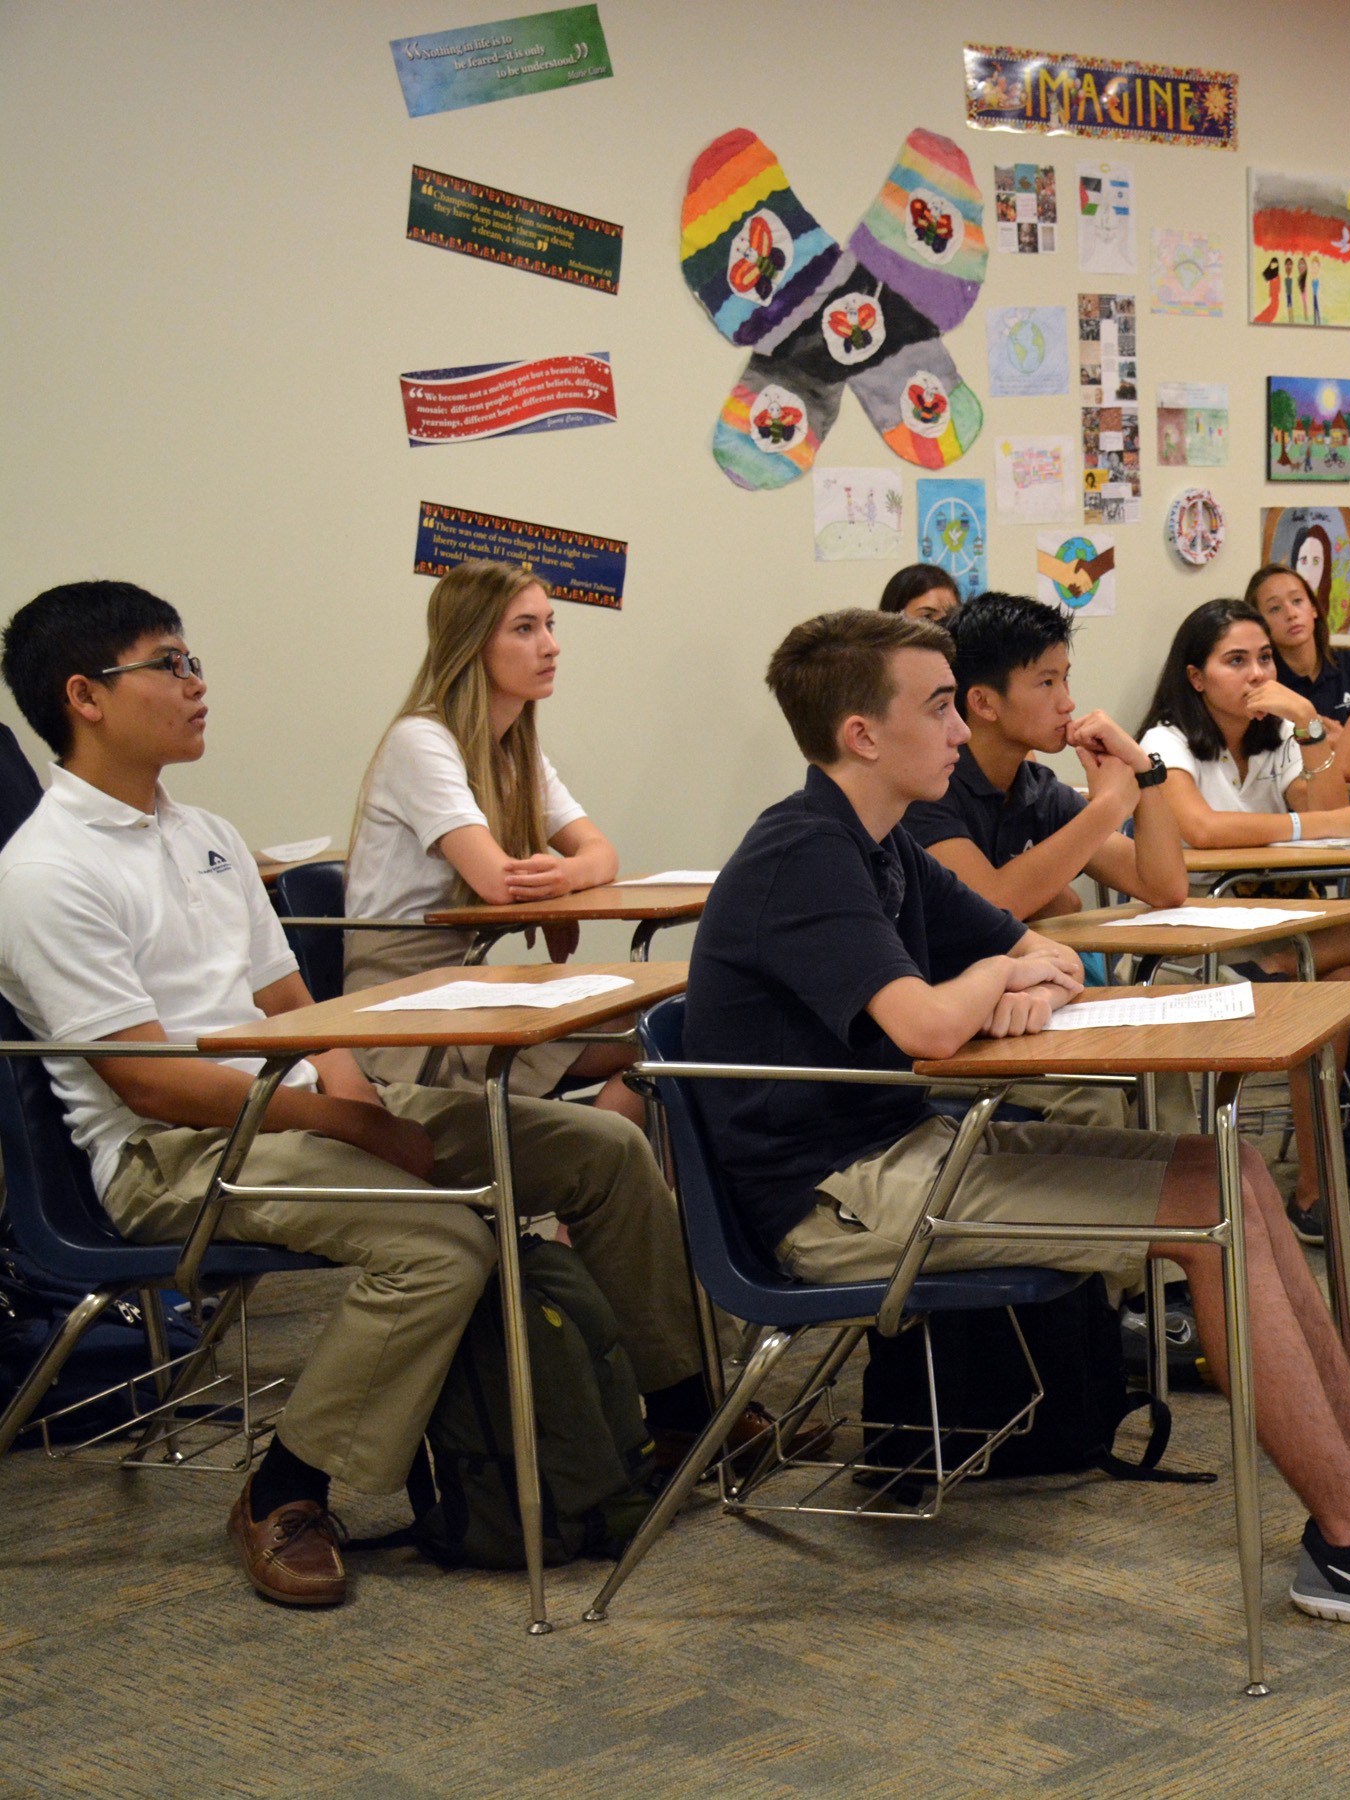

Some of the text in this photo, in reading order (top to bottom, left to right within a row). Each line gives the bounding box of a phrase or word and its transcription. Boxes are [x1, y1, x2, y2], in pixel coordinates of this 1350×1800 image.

[454, 60, 466, 70] be
[515, 49, 523, 58] is
[525, 44, 545, 57] only
[464, 42, 474, 52] in
[475, 38, 490, 49] life
[492, 36, 501, 46] is
[502, 35, 512, 45] to
[496, 69, 507, 78] to
[508, 66, 520, 76] be
[1024, 66, 1195, 132] IMAGINE
[433, 202, 451, 216] they
[453, 206, 471, 220] have
[472, 212, 491, 228] deep
[536, 221, 575, 240] something
[438, 393, 468, 402] become
[469, 390, 482, 399] not
[489, 379, 517, 394] melting
[518, 374, 530, 386] pot
[530, 369, 545, 379] but
[550, 366, 586, 375] beautiful
[450, 402, 484, 414] different
[513, 382, 545, 398] different
[575, 377, 609, 393] different
[464, 412, 497, 425] different
[522, 393, 555, 407] different
[433, 533, 458, 548] liberty
[507, 550, 527, 560] could
[528, 554, 540, 562] not
[541, 555, 558, 566] have
[440, 550, 463, 560] would
[458, 529, 472, 537] was
[473, 531, 487, 540] one
[488, 533, 497, 542] of
[513, 538, 536, 551] things
[542, 543, 557, 553] had
[563, 548, 581, 558] right
